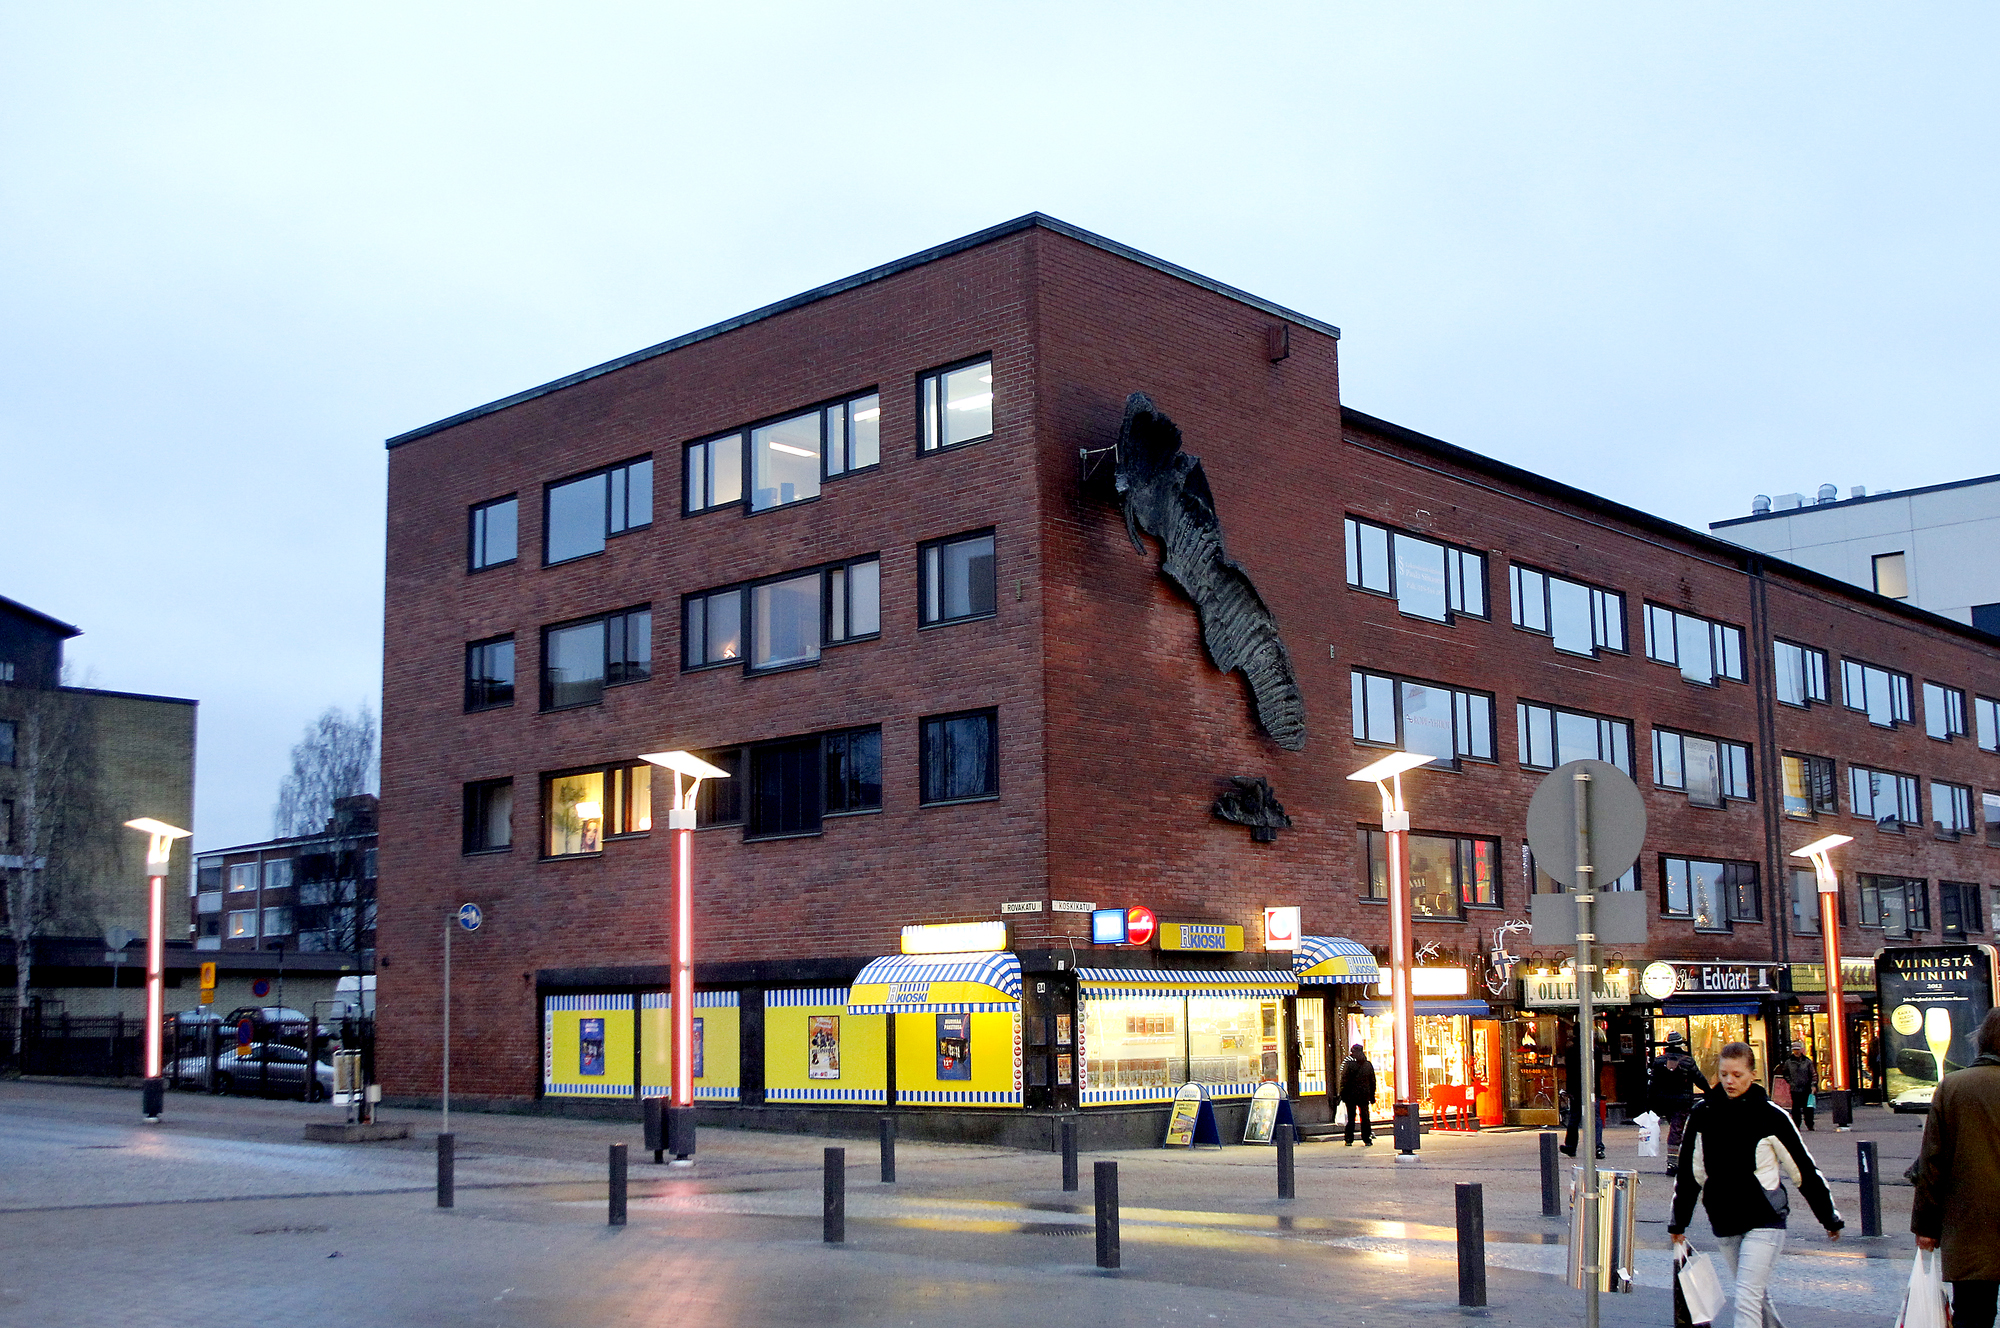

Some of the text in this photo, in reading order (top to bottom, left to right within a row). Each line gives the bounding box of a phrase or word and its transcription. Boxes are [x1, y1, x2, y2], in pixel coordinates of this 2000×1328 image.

[1007, 902, 1037, 912] ROVAKATU
[1058, 901, 1091, 911] KOSKIKATU
[1180, 925, 1226, 949] R KIOSKI
[1895, 955, 1974, 969] VIINISTÄ
[1355, 963, 1379, 974] KIOSKI
[1901, 970, 1969, 981] VIINIIN
[897, 993, 928, 1003] KIOSKI
